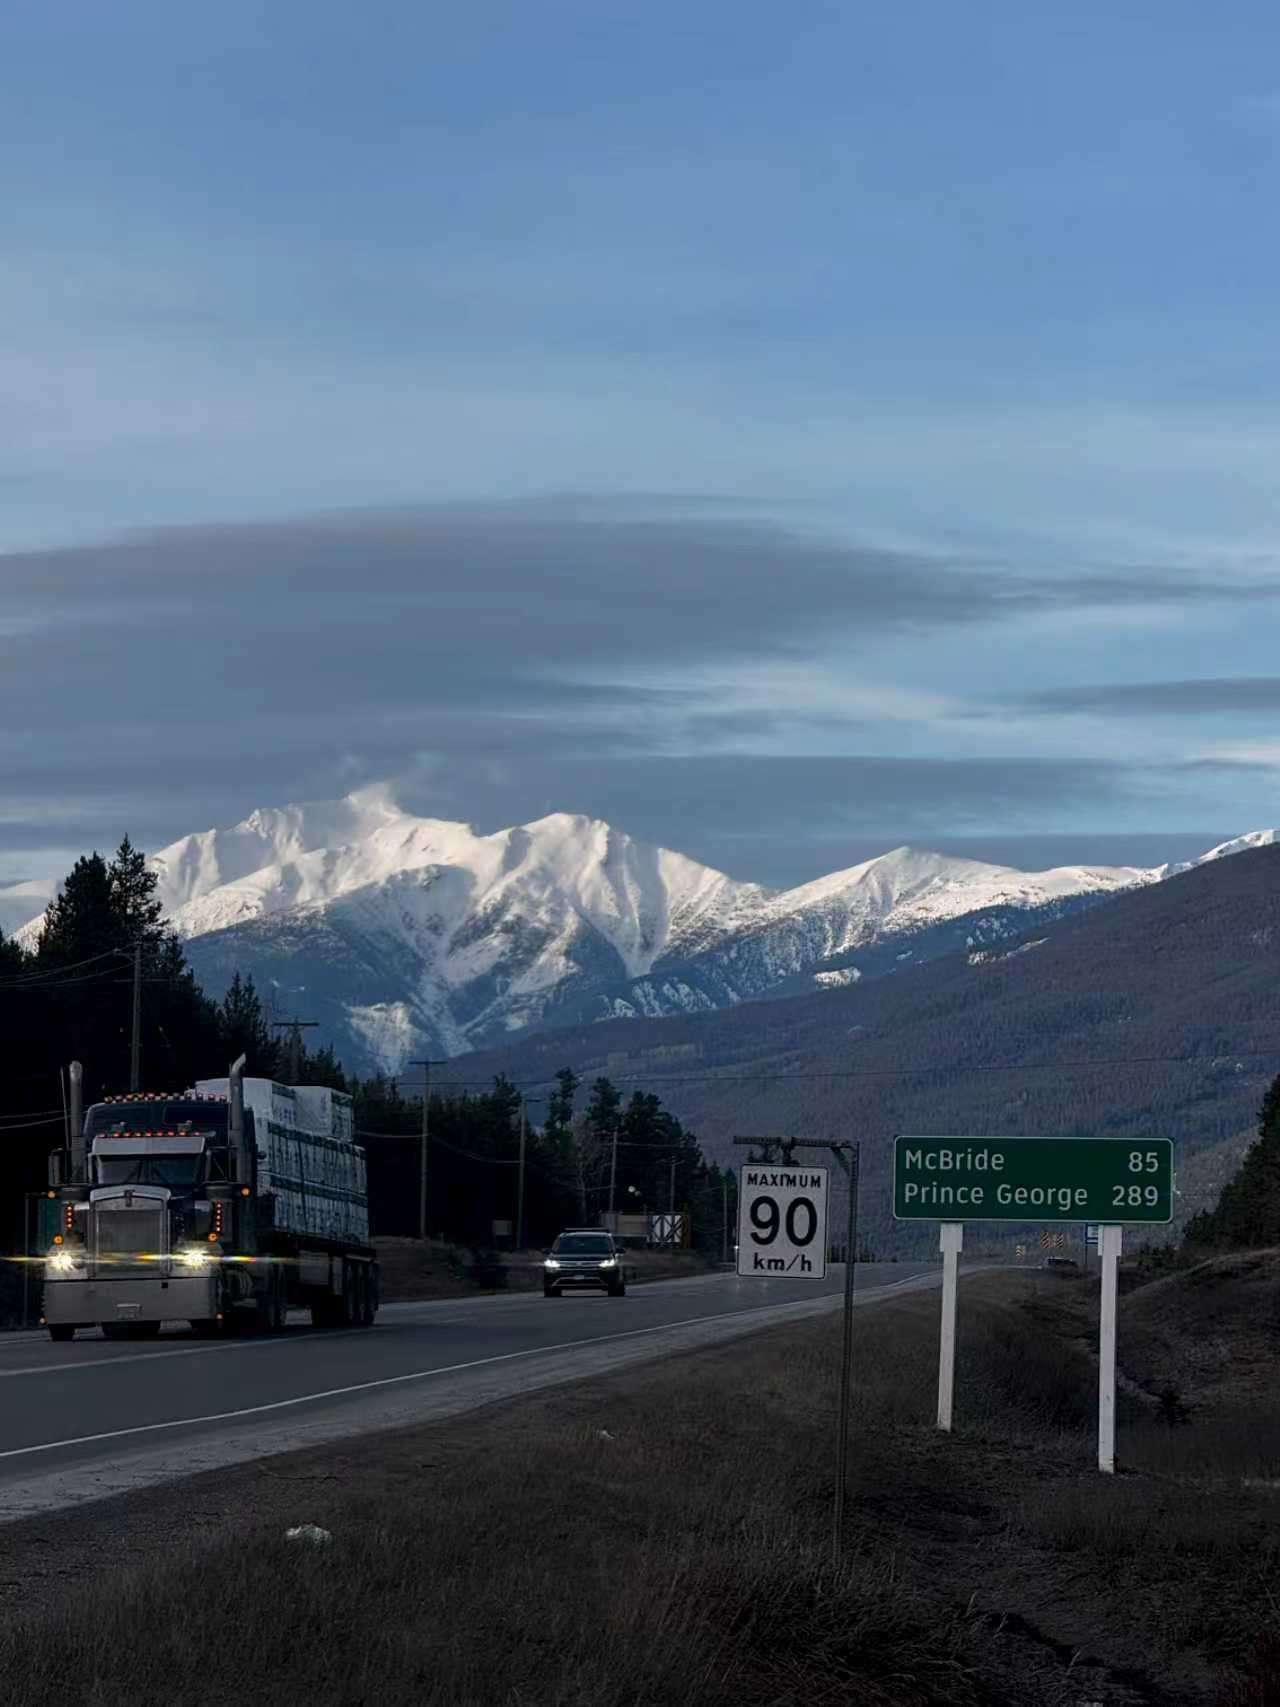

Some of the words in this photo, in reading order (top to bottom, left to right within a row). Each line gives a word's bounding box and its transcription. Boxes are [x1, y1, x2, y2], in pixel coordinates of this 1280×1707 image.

[905, 1149, 1004, 1171] McBride
[1128, 1152, 1159, 1172] 85
[747, 1173, 822, 1189] MAXIMUM
[904, 1182, 984, 1204] Prince
[996, 1183, 1088, 1211] George
[1112, 1186, 1159, 1207] 289
[750, 1196, 818, 1246] 90
[753, 1252, 812, 1272] km/h
